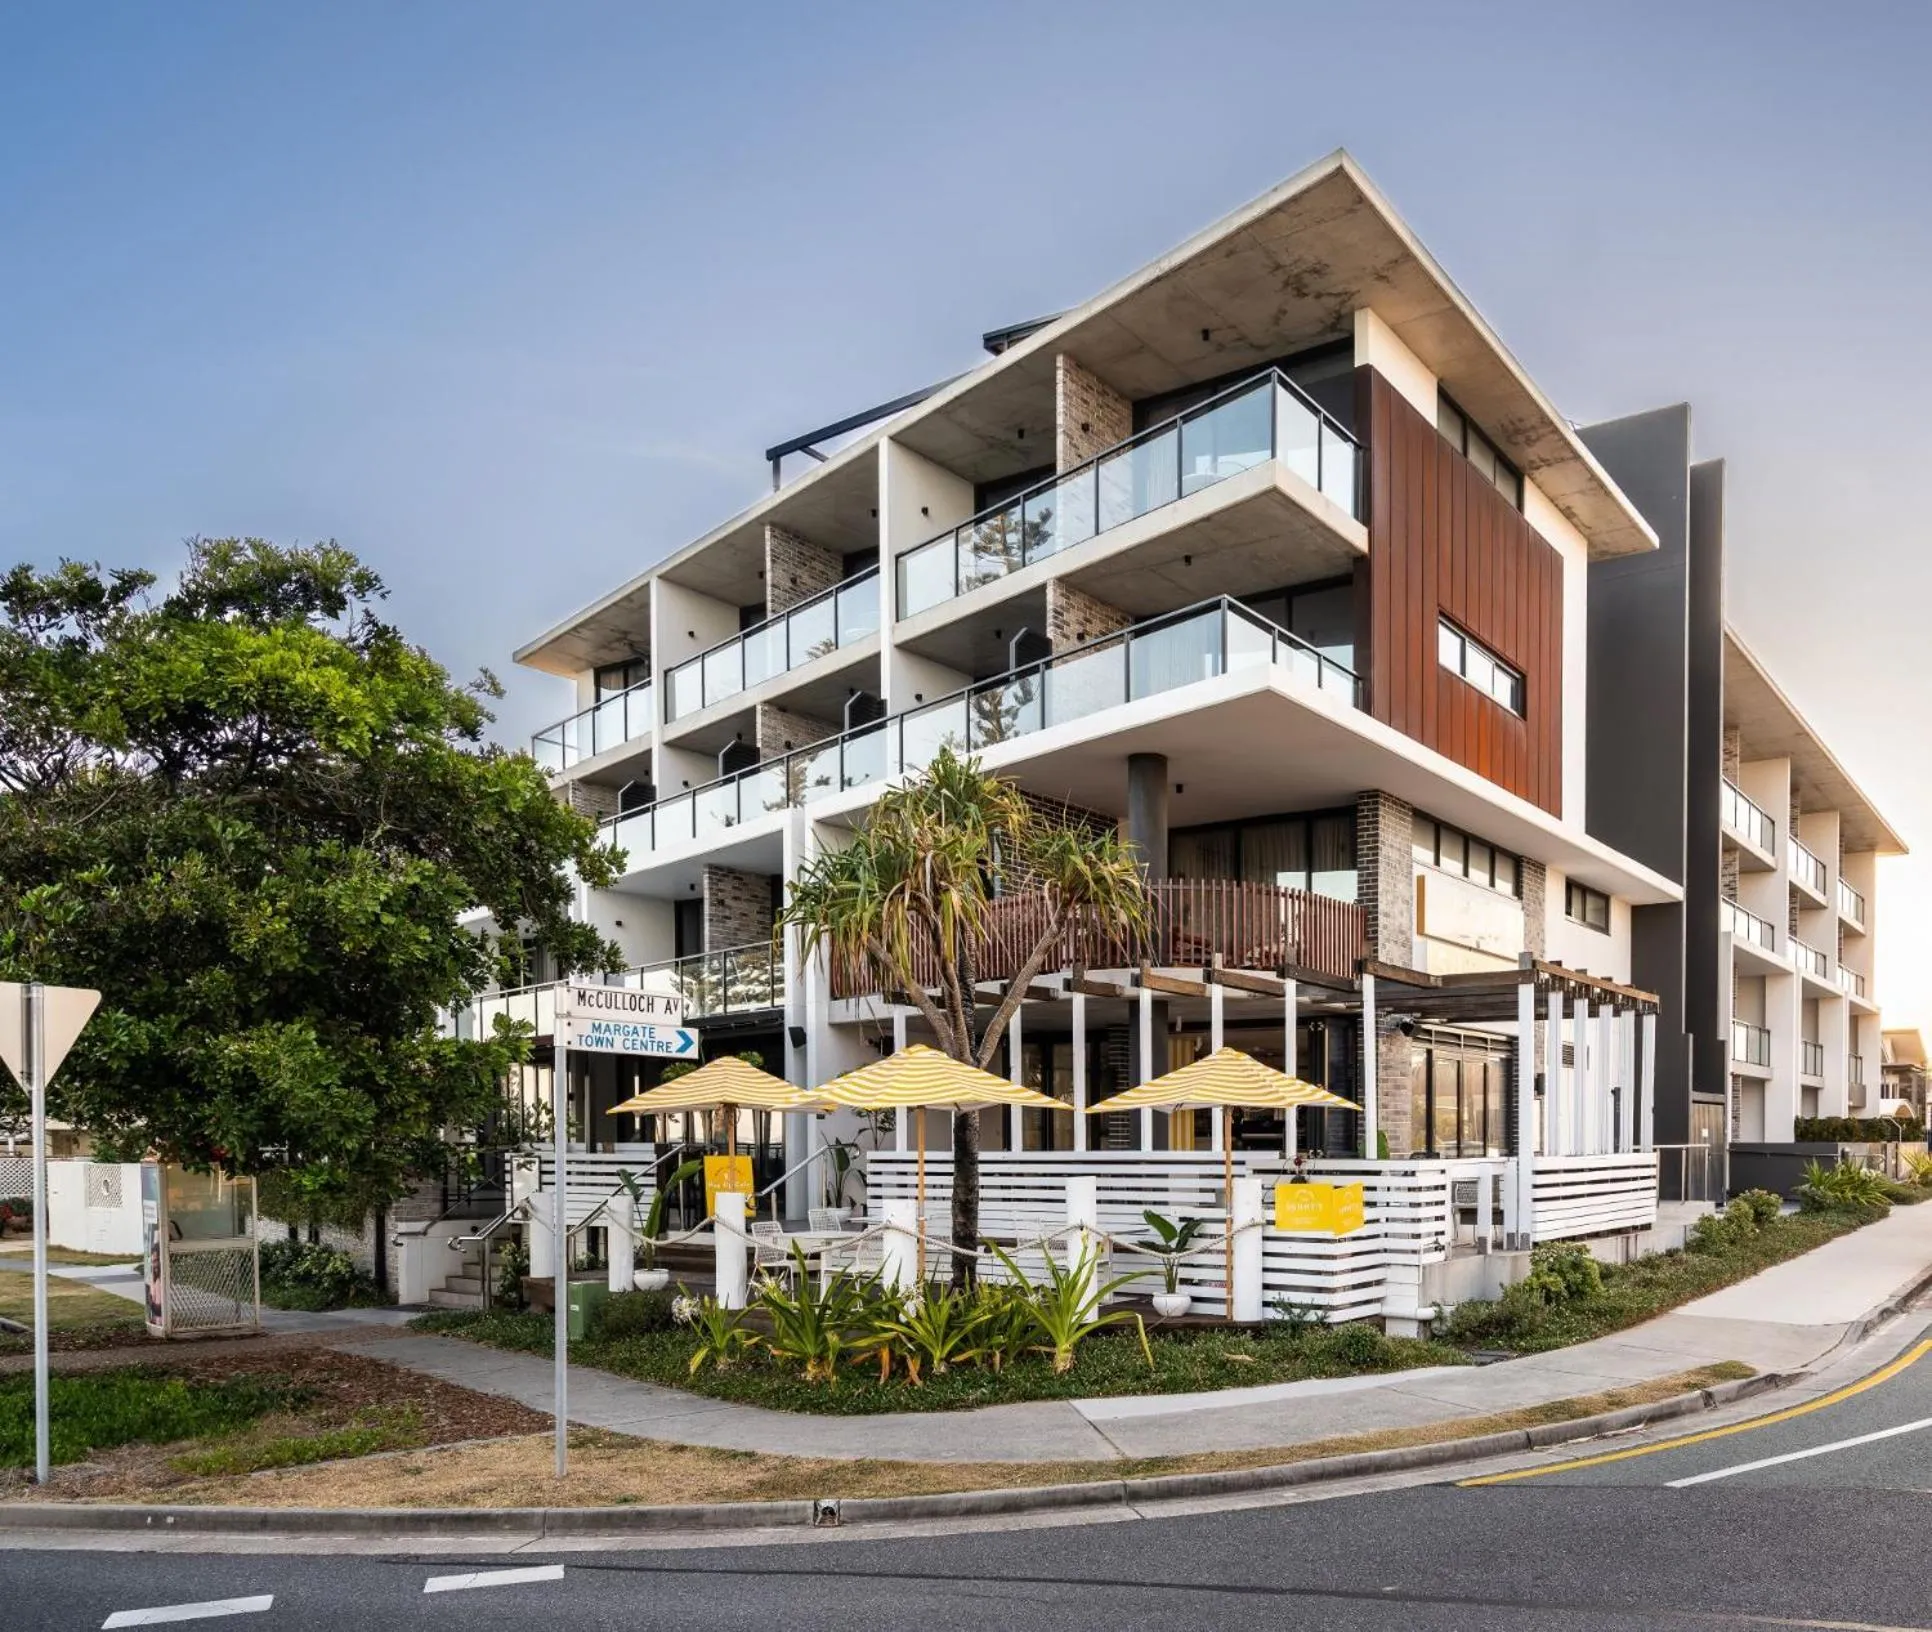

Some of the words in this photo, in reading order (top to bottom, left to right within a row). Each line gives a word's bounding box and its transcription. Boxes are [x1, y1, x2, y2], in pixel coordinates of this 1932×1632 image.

[577, 989, 654, 1013] McCULLOCH
[664, 998, 680, 1014] AV
[591, 1022, 656, 1039] MARGATE
[577, 1034, 614, 1049] TOWN
[622, 1037, 673, 1053] CENTRE
